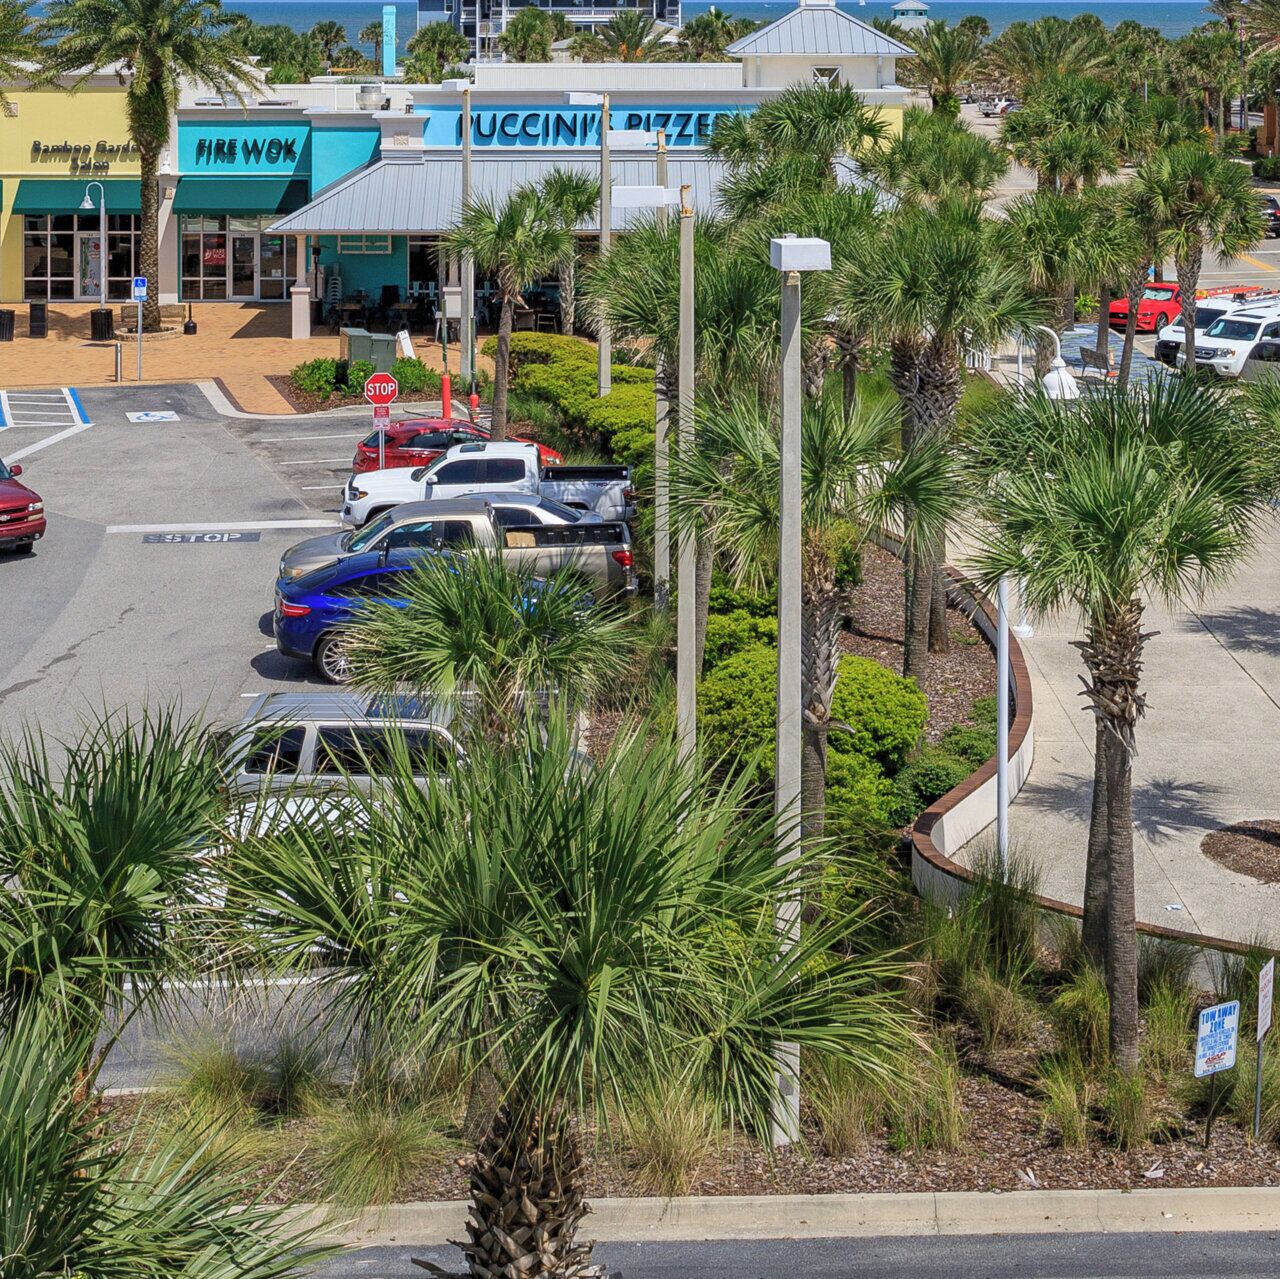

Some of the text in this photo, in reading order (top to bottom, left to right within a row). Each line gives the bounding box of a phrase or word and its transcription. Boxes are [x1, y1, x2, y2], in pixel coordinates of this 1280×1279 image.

[628, 113, 754, 138] PIZZE
[32, 140, 140, 153] Bamboo Garde
[197, 138, 297, 157] FIRE WOK
[367, 383, 396, 396] STOP
[164, 533, 242, 543] STOP
[1202, 1004, 1237, 1025] TOW AWAY
[1209, 1018, 1226, 1033] ZONE
